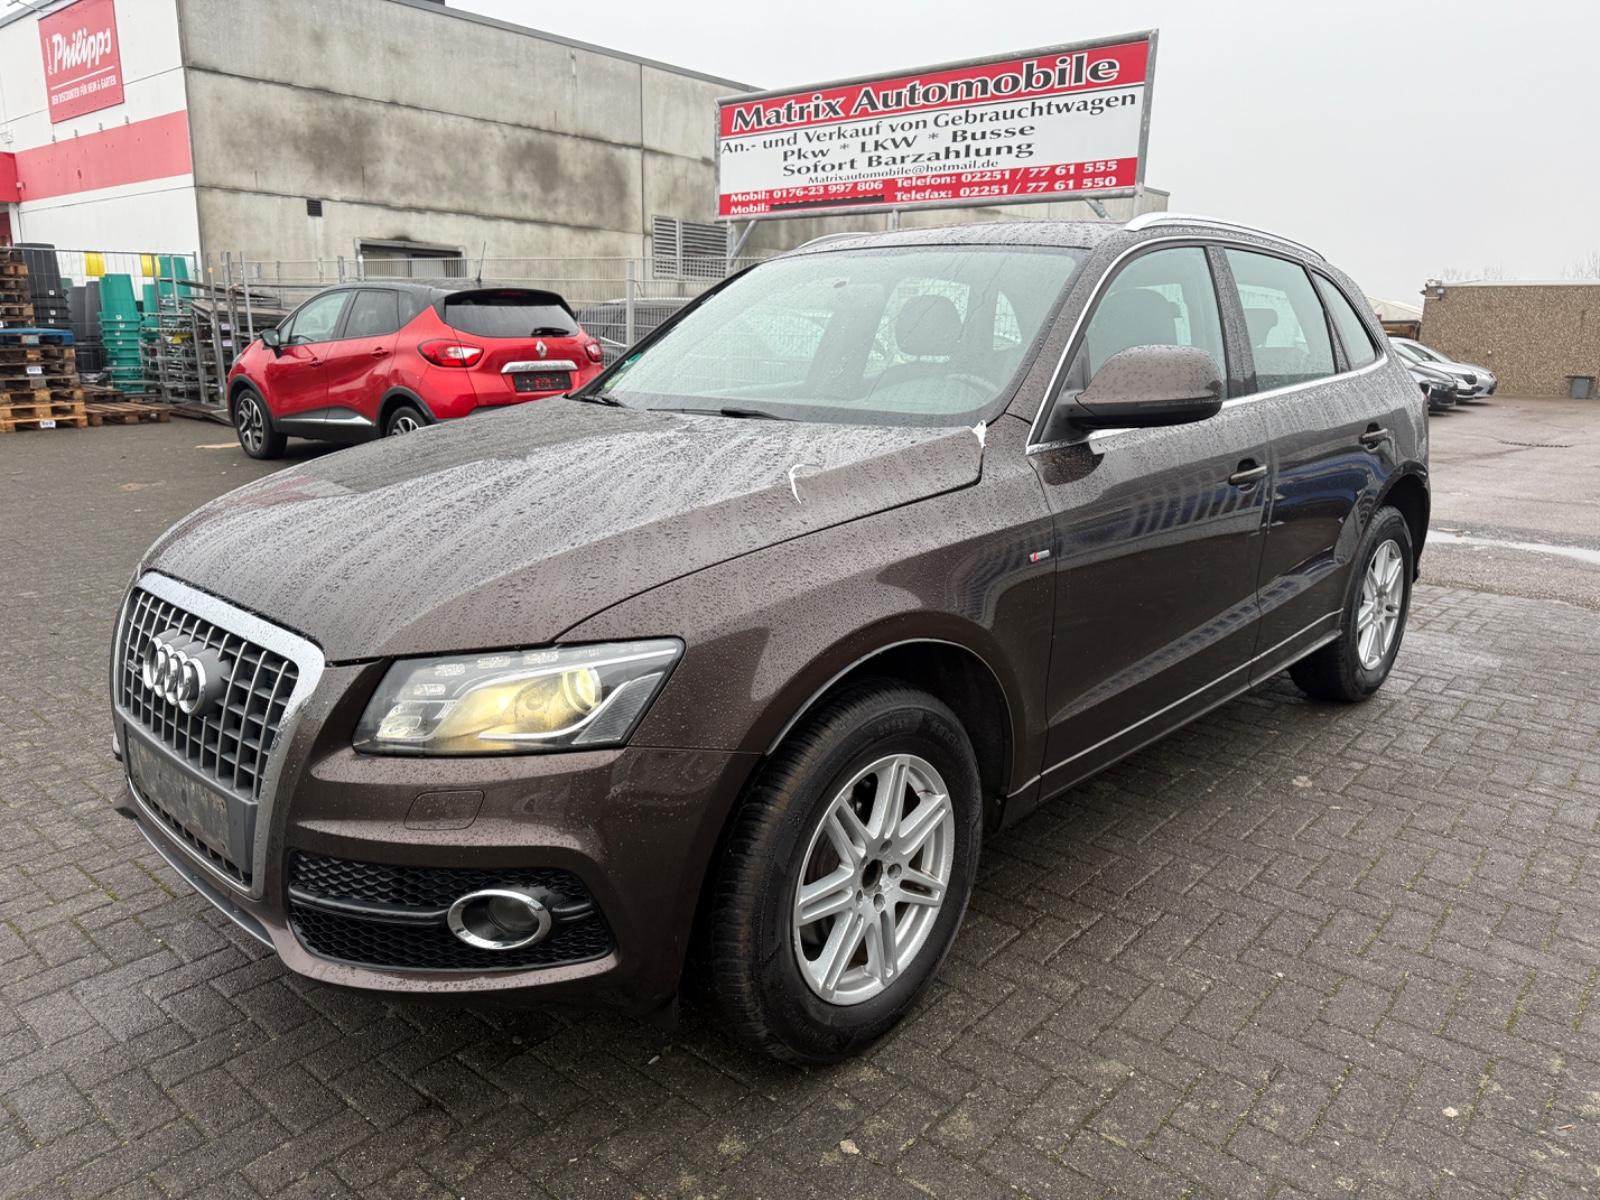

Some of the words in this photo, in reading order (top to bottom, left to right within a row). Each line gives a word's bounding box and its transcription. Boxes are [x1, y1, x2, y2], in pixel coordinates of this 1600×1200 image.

[52, 28, 111, 73] Philipps
[731, 94, 846, 132] Matrix
[850, 53, 1120, 116] Automobile
[722, 141, 757, 154] An.-
[763, 132, 798, 149] und
[804, 121, 882, 143] Verkauf
[889, 118, 927, 133] von
[933, 93, 1136, 128] Gebrauchtwagen
[783, 148, 830, 162] Pkw
[860, 135, 918, 153] LKW
[952, 125, 1035, 143] Busse
[783, 158, 858, 177] Sofort
[867, 142, 1035, 168] Barzahlung
[808, 159, 999, 184] Matrixautomobile@hotmail.de
[896, 175, 956, 189] Telefon:
[961, 170, 1011, 182] 02251
[1016, 167, 1025, 180] /
[1028, 166, 1051, 178] 77
[1055, 164, 1076, 176] 61
[1083, 161, 1118, 173] 555
[730, 192, 770, 203] Mobil:
[773, 185, 824, 198] 0176-23
[828, 183, 853, 194] 997
[857, 180, 883, 192] 806
[895, 189, 952, 202] Telefax:
[960, 184, 1008, 197] 02251
[1012, 182, 1021, 195] /
[1026, 181, 1049, 193] 77
[1054, 179, 1075, 191] 61
[1081, 176, 1117, 189] 550
[730, 203, 770, 215] Mobil:
